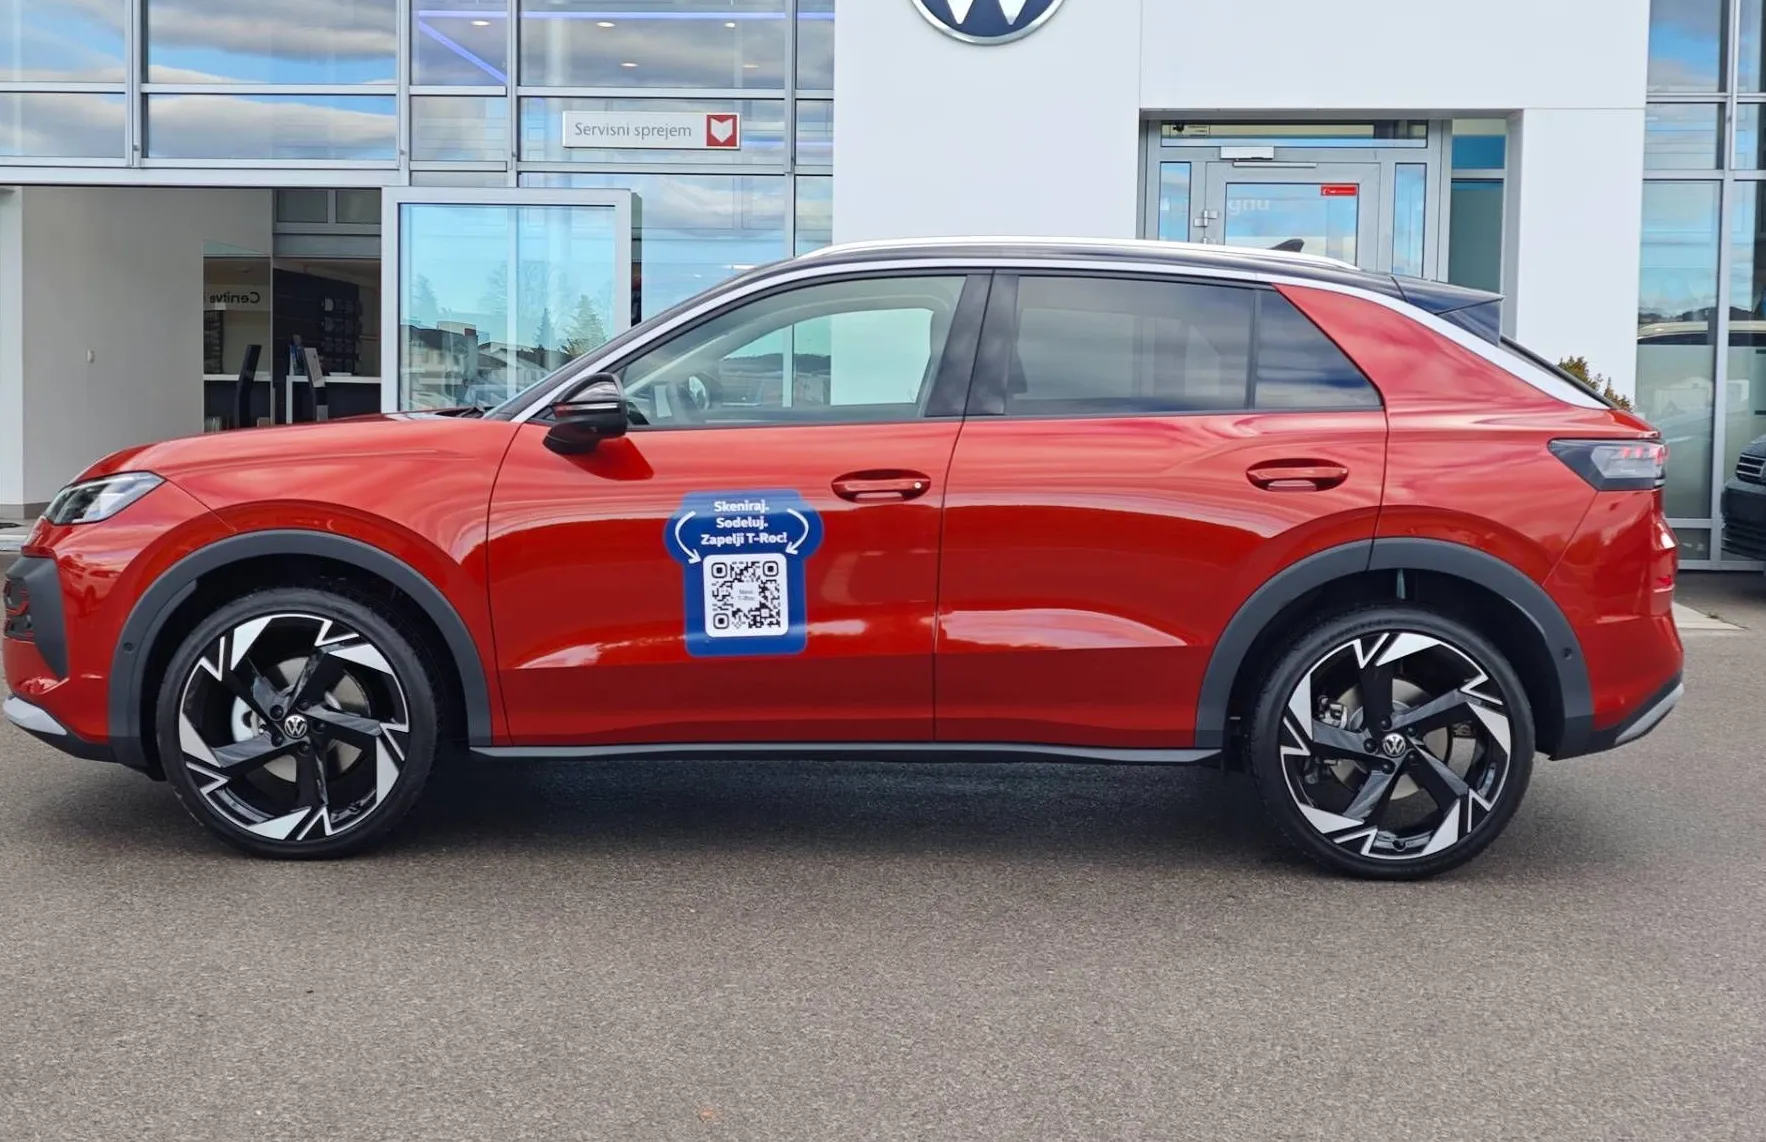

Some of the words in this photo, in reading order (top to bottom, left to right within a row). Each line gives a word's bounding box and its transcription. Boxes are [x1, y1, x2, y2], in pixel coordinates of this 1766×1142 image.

[574, 122, 629, 136] Servisni
[634, 123, 692, 140] sprejem
[713, 499, 770, 514] Skeniraj.
[716, 516, 769, 530] Sodeluj.
[701, 533, 745, 548] Zapelji
[746, 531, 788, 544] T-Roc!
